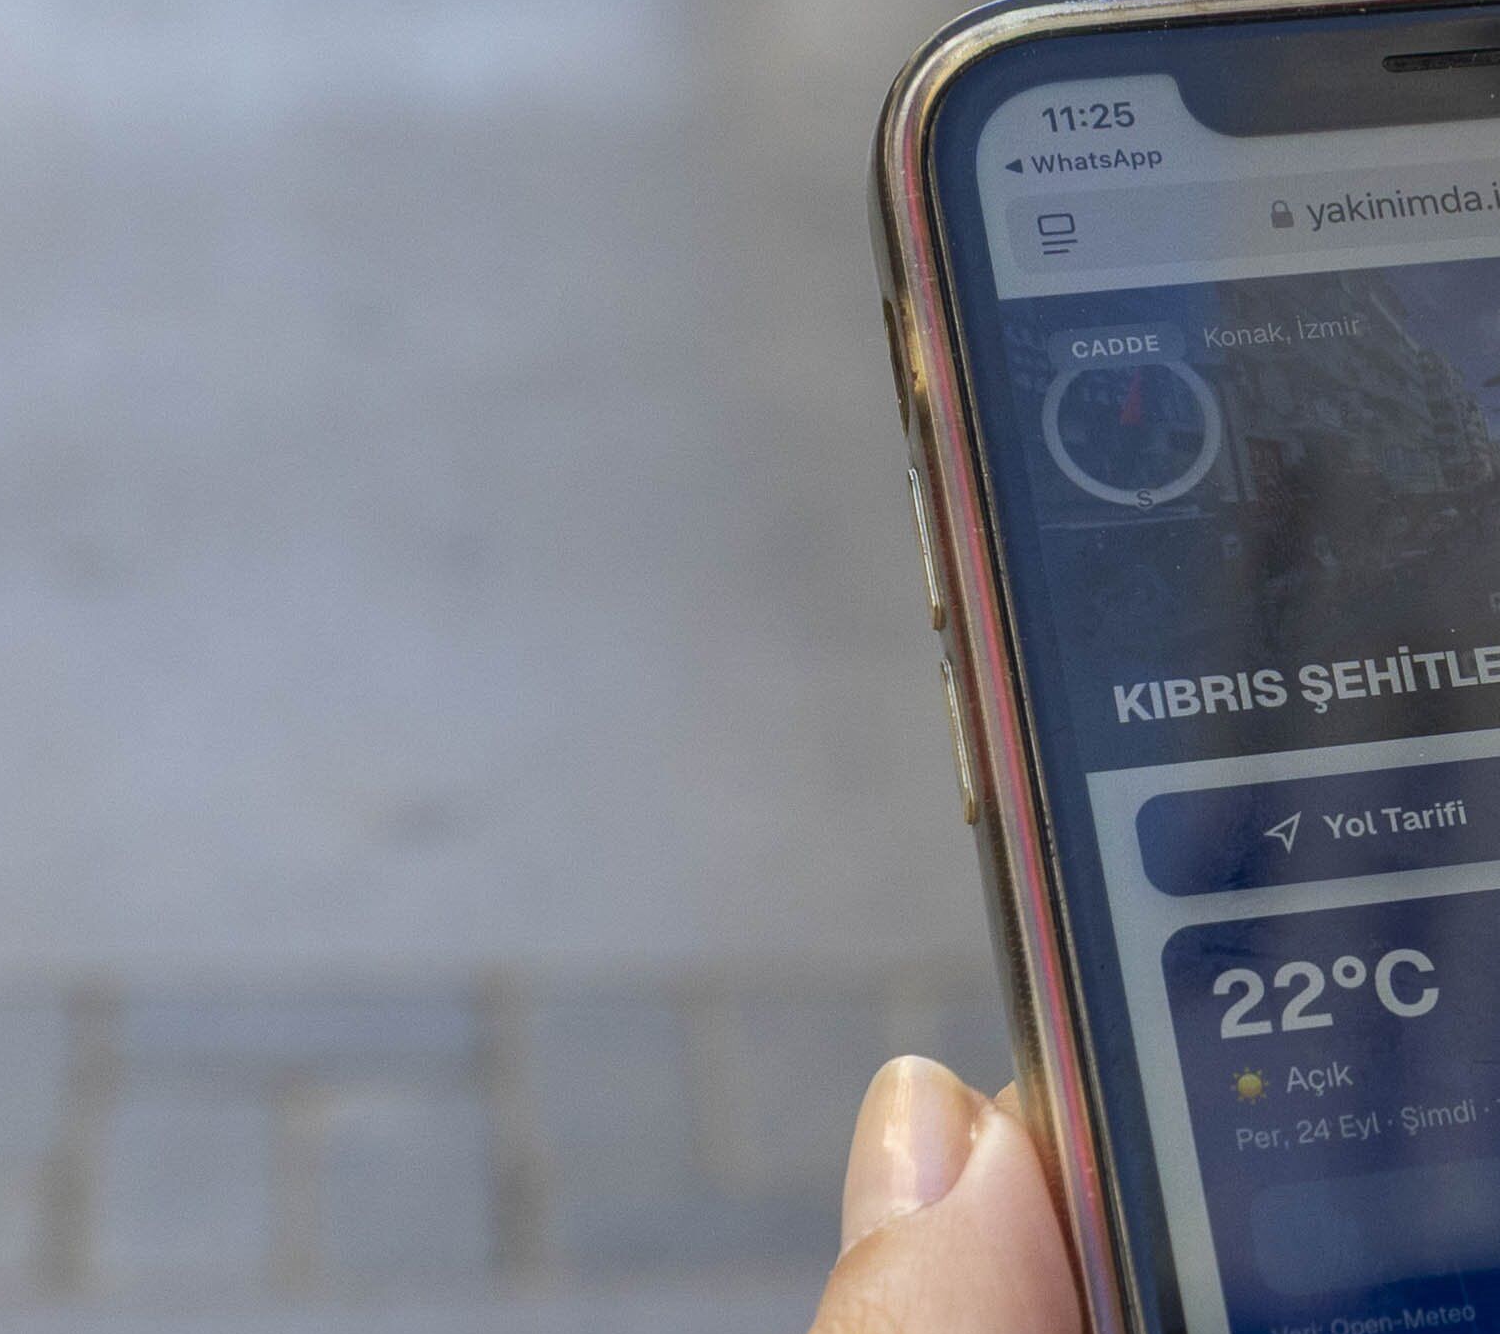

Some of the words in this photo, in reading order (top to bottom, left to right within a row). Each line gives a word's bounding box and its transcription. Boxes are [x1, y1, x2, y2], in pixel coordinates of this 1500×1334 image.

[1042, 102, 1136, 132] 11:25
[1032, 147, 1163, 174] WhatsApp
[1071, 334, 1160, 358] CADDE
[1204, 322, 1291, 348] Konak,
[1297, 316, 1360, 340] İzmir
[1113, 668, 1288, 723] KIBRIS
[1323, 810, 1377, 840] Yol
[1381, 800, 1467, 832] Tarifi
[1212, 948, 1440, 1039] 22°C
[1286, 1062, 1354, 1097] Açık
[1235, 1126, 1290, 1152] Per,
[1297, 1120, 1332, 1145] 24
[1340, 1111, 1380, 1142] Eyl
[1400, 1099, 1477, 1136] Şimdi
